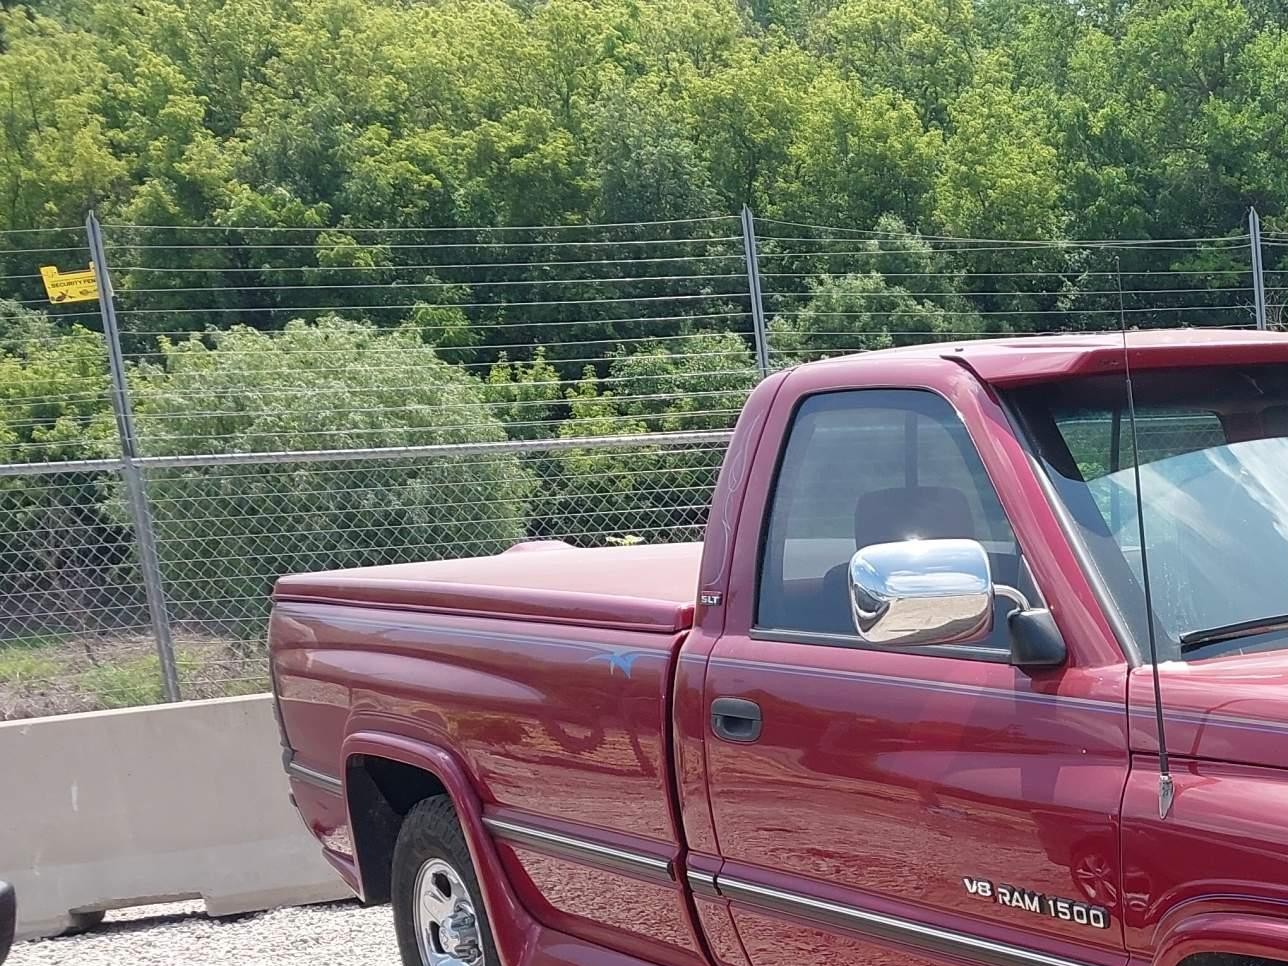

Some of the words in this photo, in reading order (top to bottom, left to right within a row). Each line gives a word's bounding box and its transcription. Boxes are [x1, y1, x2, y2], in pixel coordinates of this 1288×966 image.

[51, 280, 82, 288] SECURITY
[701, 595, 721, 604] SLT
[963, 878, 992, 897] V8
[997, 886, 1041, 914] RAM
[1047, 898, 1106, 929] 1500
